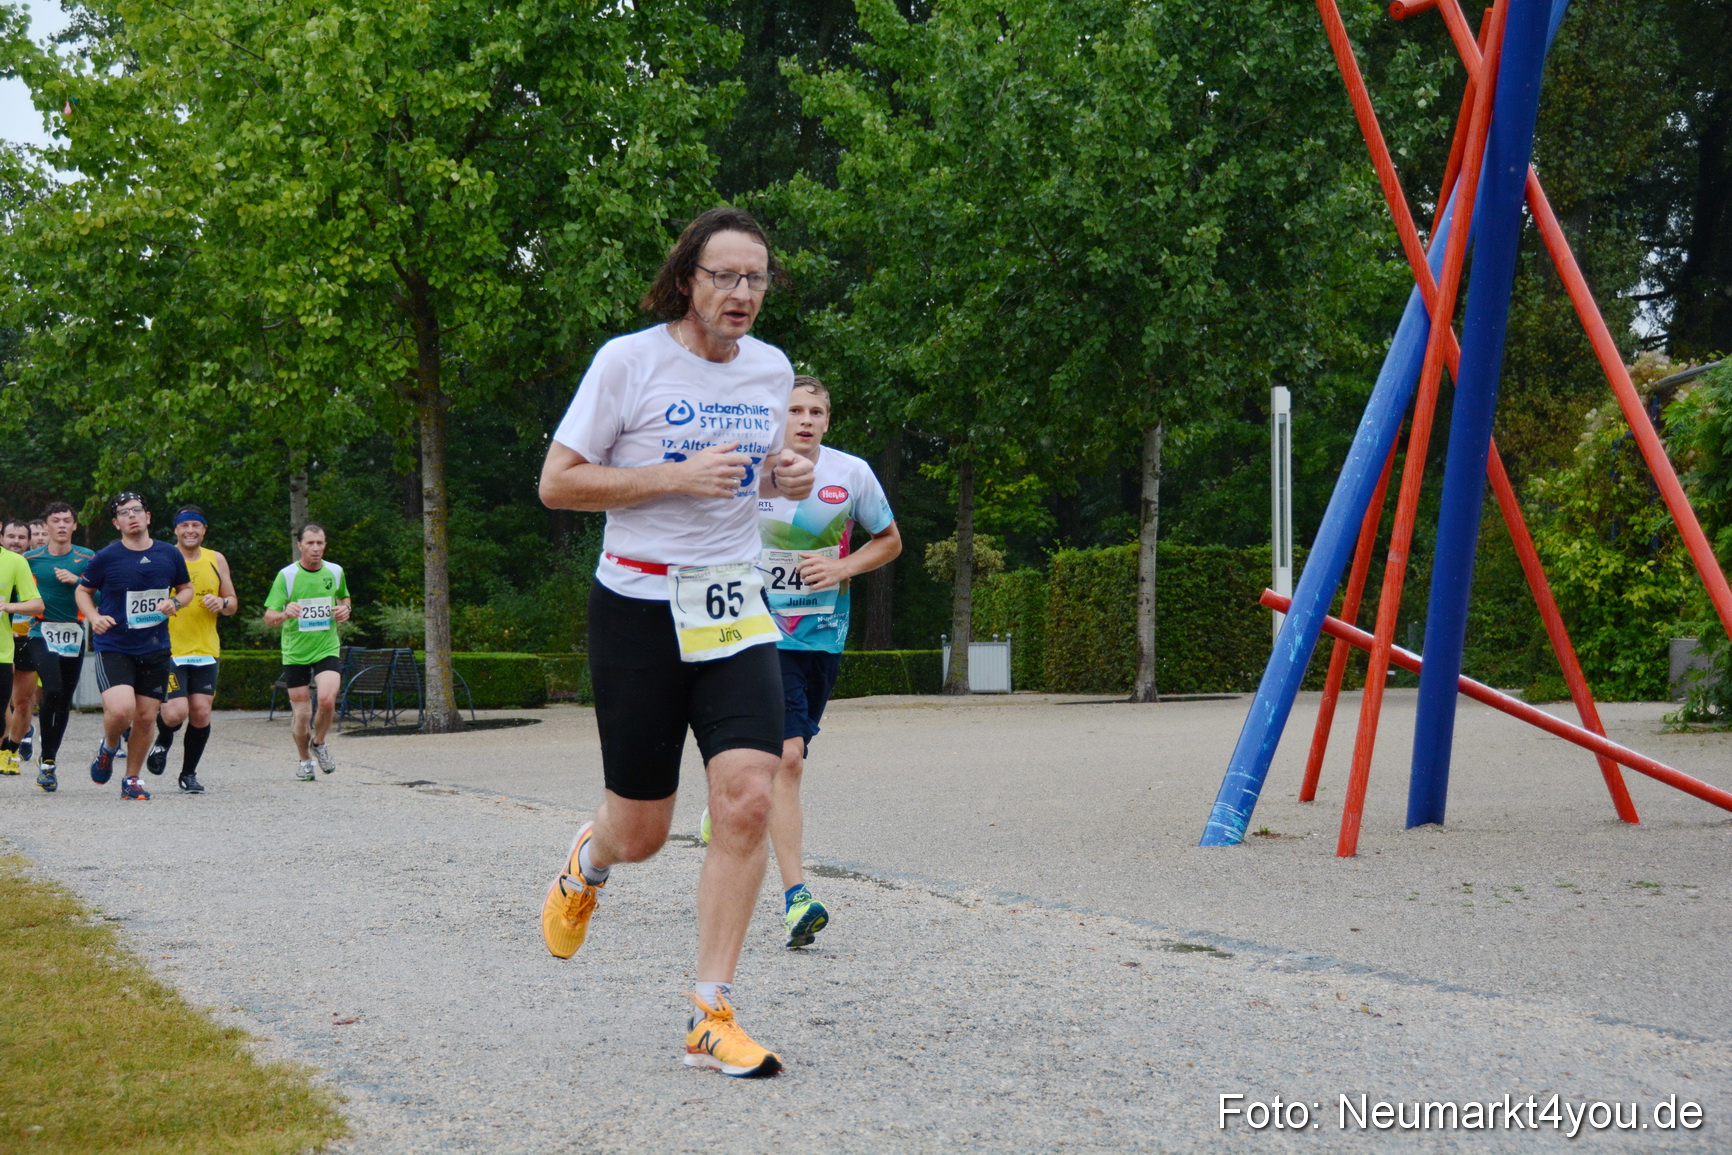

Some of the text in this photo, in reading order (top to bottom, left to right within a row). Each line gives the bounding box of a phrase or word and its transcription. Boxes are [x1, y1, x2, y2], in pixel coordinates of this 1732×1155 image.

[700, 416, 770, 431] STIFTUNG
[661, 439, 677, 449] 17.
[706, 580, 744, 620] 65
[786, 597, 818, 607] Julian
[302, 605, 331, 619] 2553
[46, 631, 78, 644] 3101
